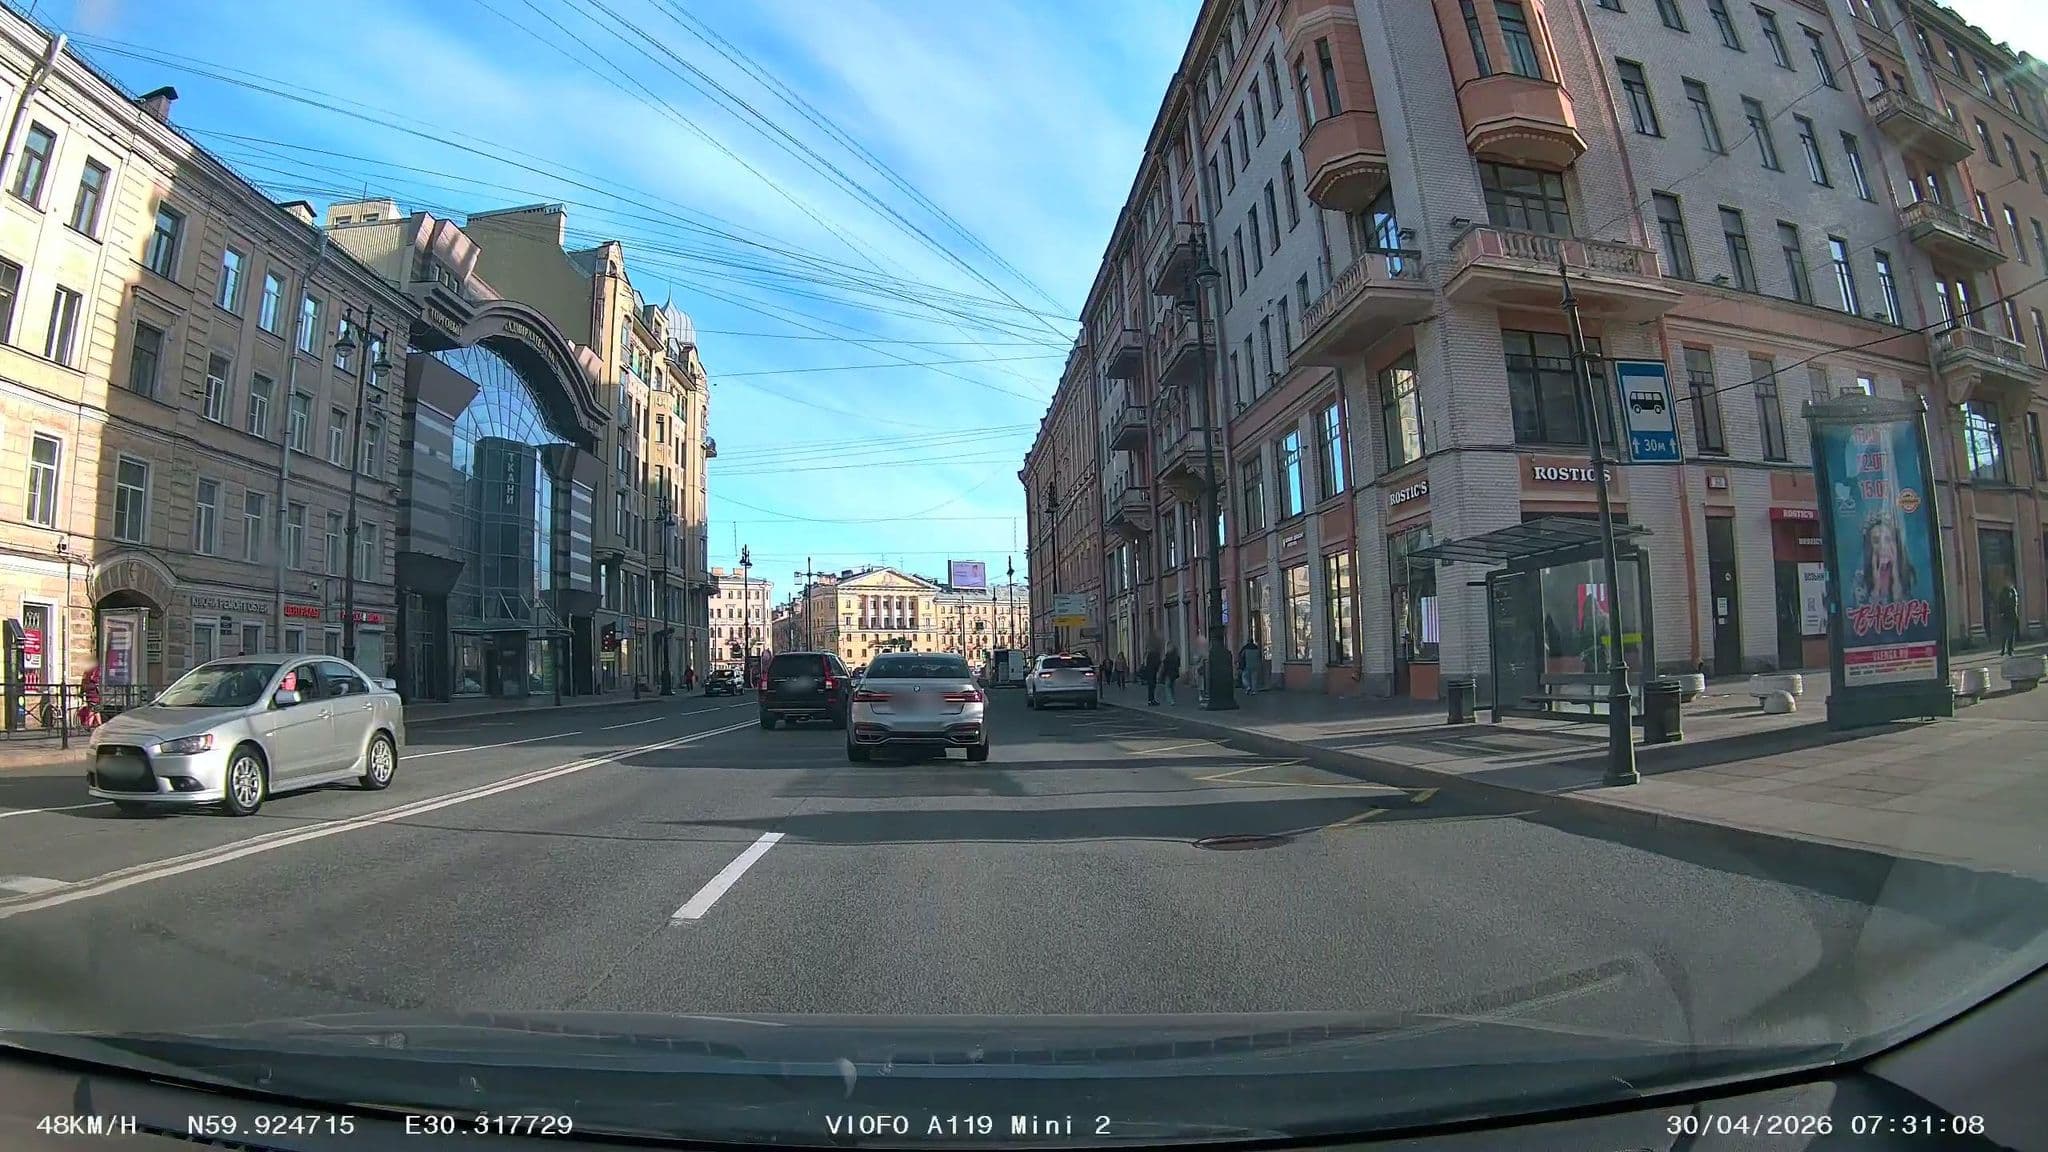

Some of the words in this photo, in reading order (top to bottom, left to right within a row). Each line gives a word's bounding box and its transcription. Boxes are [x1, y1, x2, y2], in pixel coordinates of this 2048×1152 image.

[1643, 439, 1666, 452] 30м
[506, 452, 515, 505] ТКАНИ
[1534, 466, 1611, 482] ROSTICS
[1390, 481, 1428, 505] ROSTIC'S
